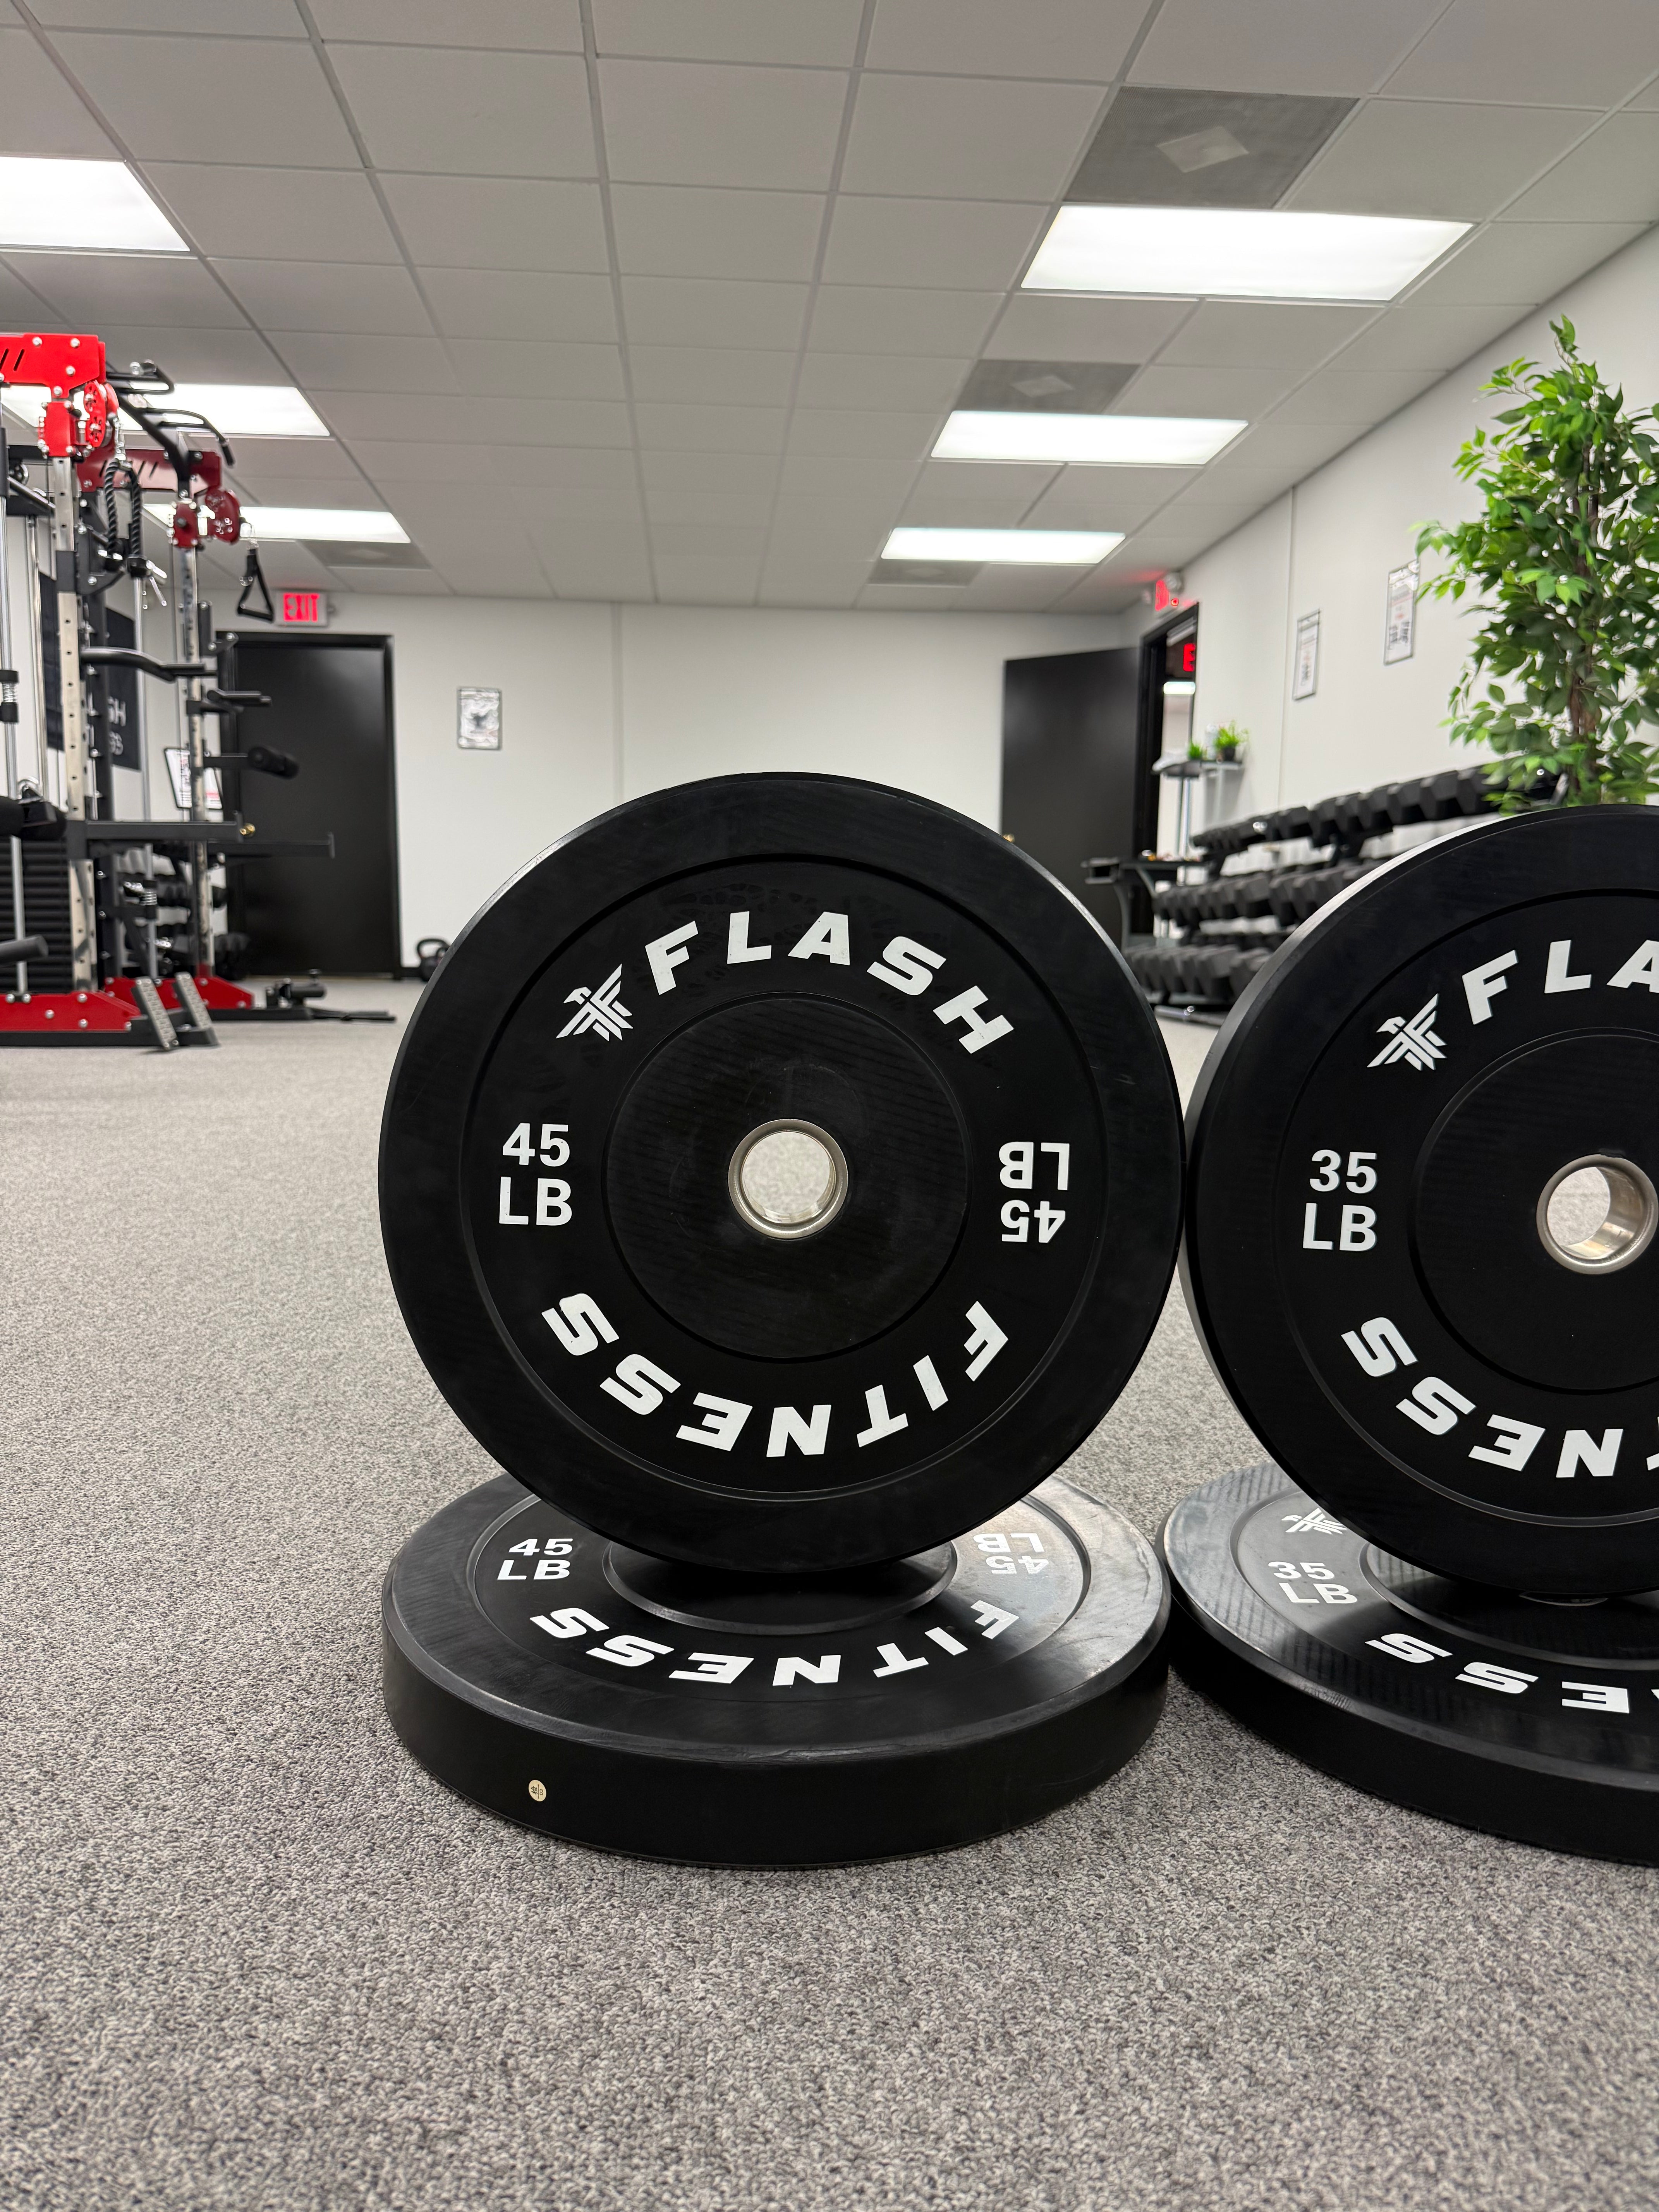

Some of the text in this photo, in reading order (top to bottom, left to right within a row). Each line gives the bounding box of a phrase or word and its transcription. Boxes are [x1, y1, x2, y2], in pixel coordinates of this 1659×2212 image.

[283, 592, 319, 622] EXIT
[645, 911, 1014, 1054] FLASH
[1462, 940, 1659, 1025] FLA
[502, 1123, 570, 1167] 45
[999, 1142, 1070, 1190] LB
[1309, 1149, 1376, 1194] 35
[499, 1176, 572, 1226] LB
[1000, 1200, 1065, 1243] 45
[1303, 1202, 1376, 1251] LB
[541, 1293, 1008, 1457] FITNESS
[1341, 1317, 1659, 1478] NESS
[508, 1538, 573, 1556] 45
[973, 1533, 1045, 1553] LB
[986, 1555, 1049, 1574] 45
[497, 1559, 570, 1580] LB
[1268, 1561, 1335, 1580] 35
[1278, 1582, 1358, 1604] LB
[529, 1599, 1019, 1686] FITNESS
[1365, 1633, 1659, 1714] ESS
